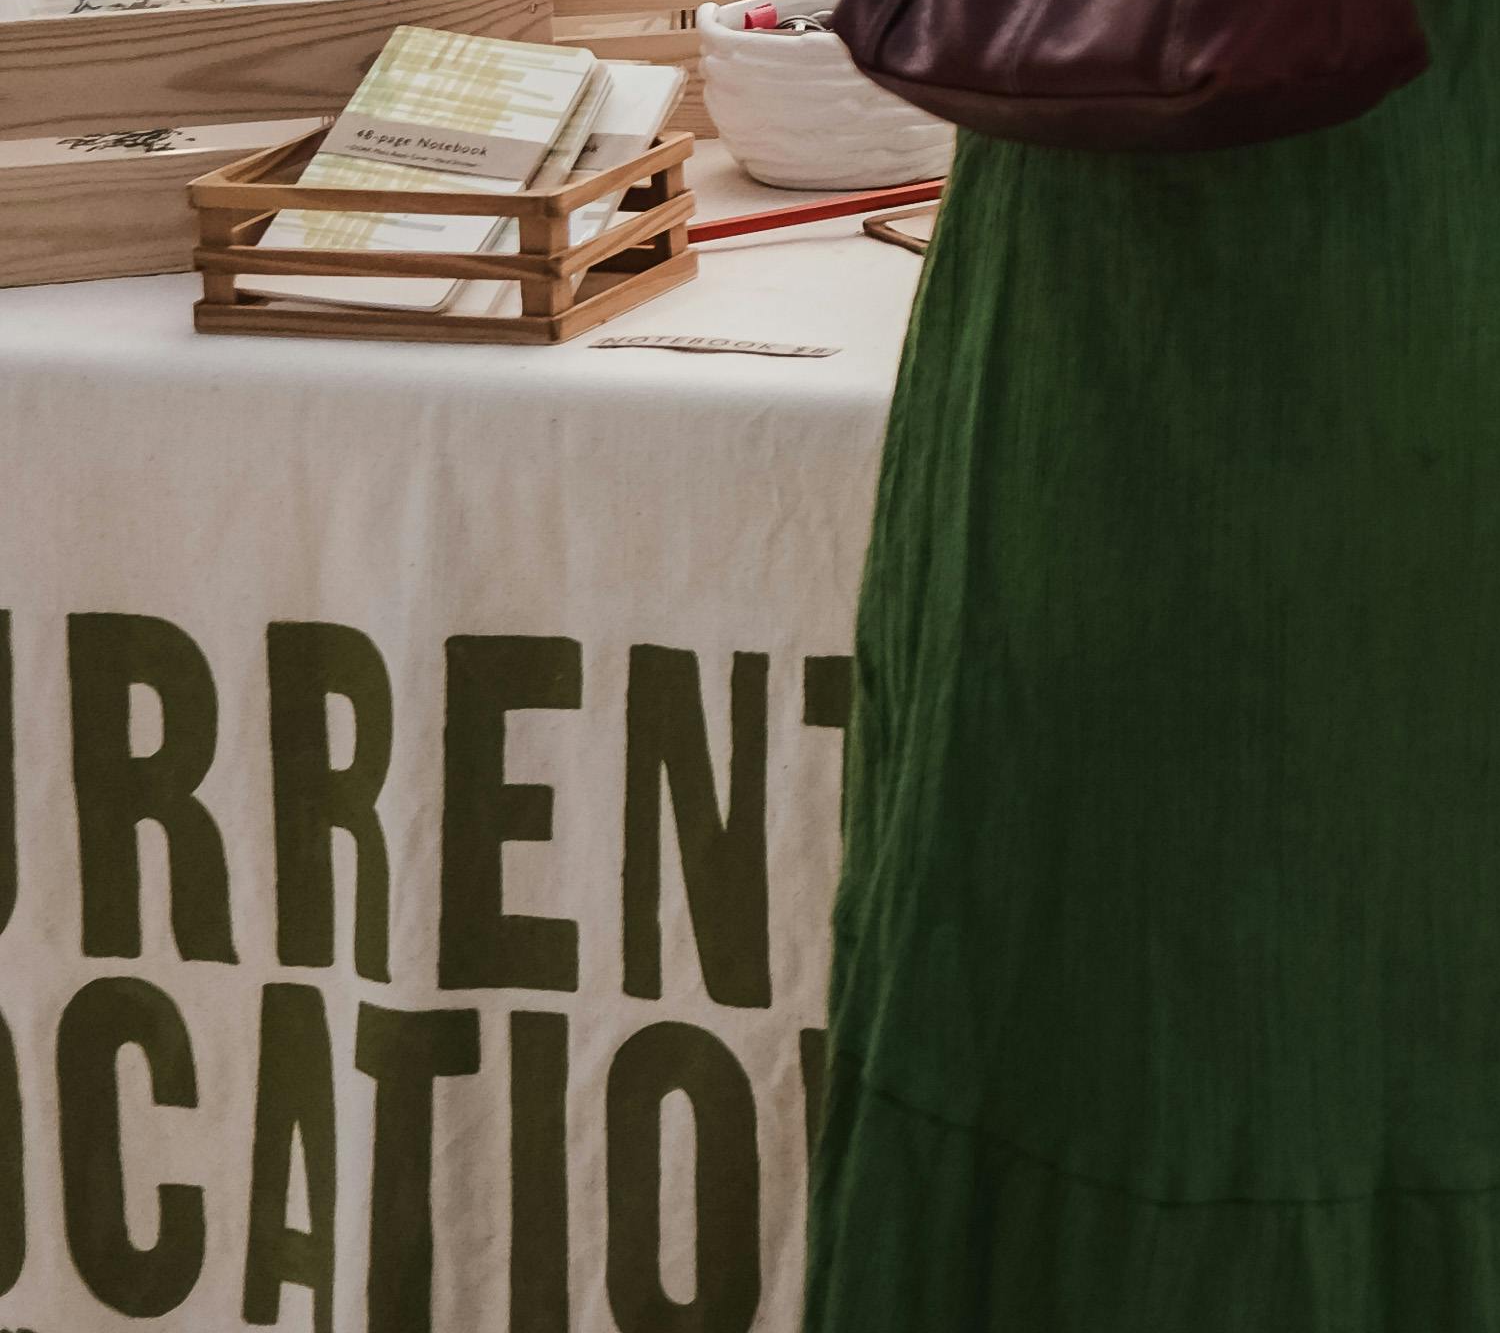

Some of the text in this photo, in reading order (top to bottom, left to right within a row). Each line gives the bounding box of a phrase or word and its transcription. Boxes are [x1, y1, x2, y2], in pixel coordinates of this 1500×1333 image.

[416, 137, 487, 156] Notebook
[602, 336, 774, 350] NOTEBOOK
[0, 609, 855, 1009] RREN
[0, 976, 828, 1333] CATIO
